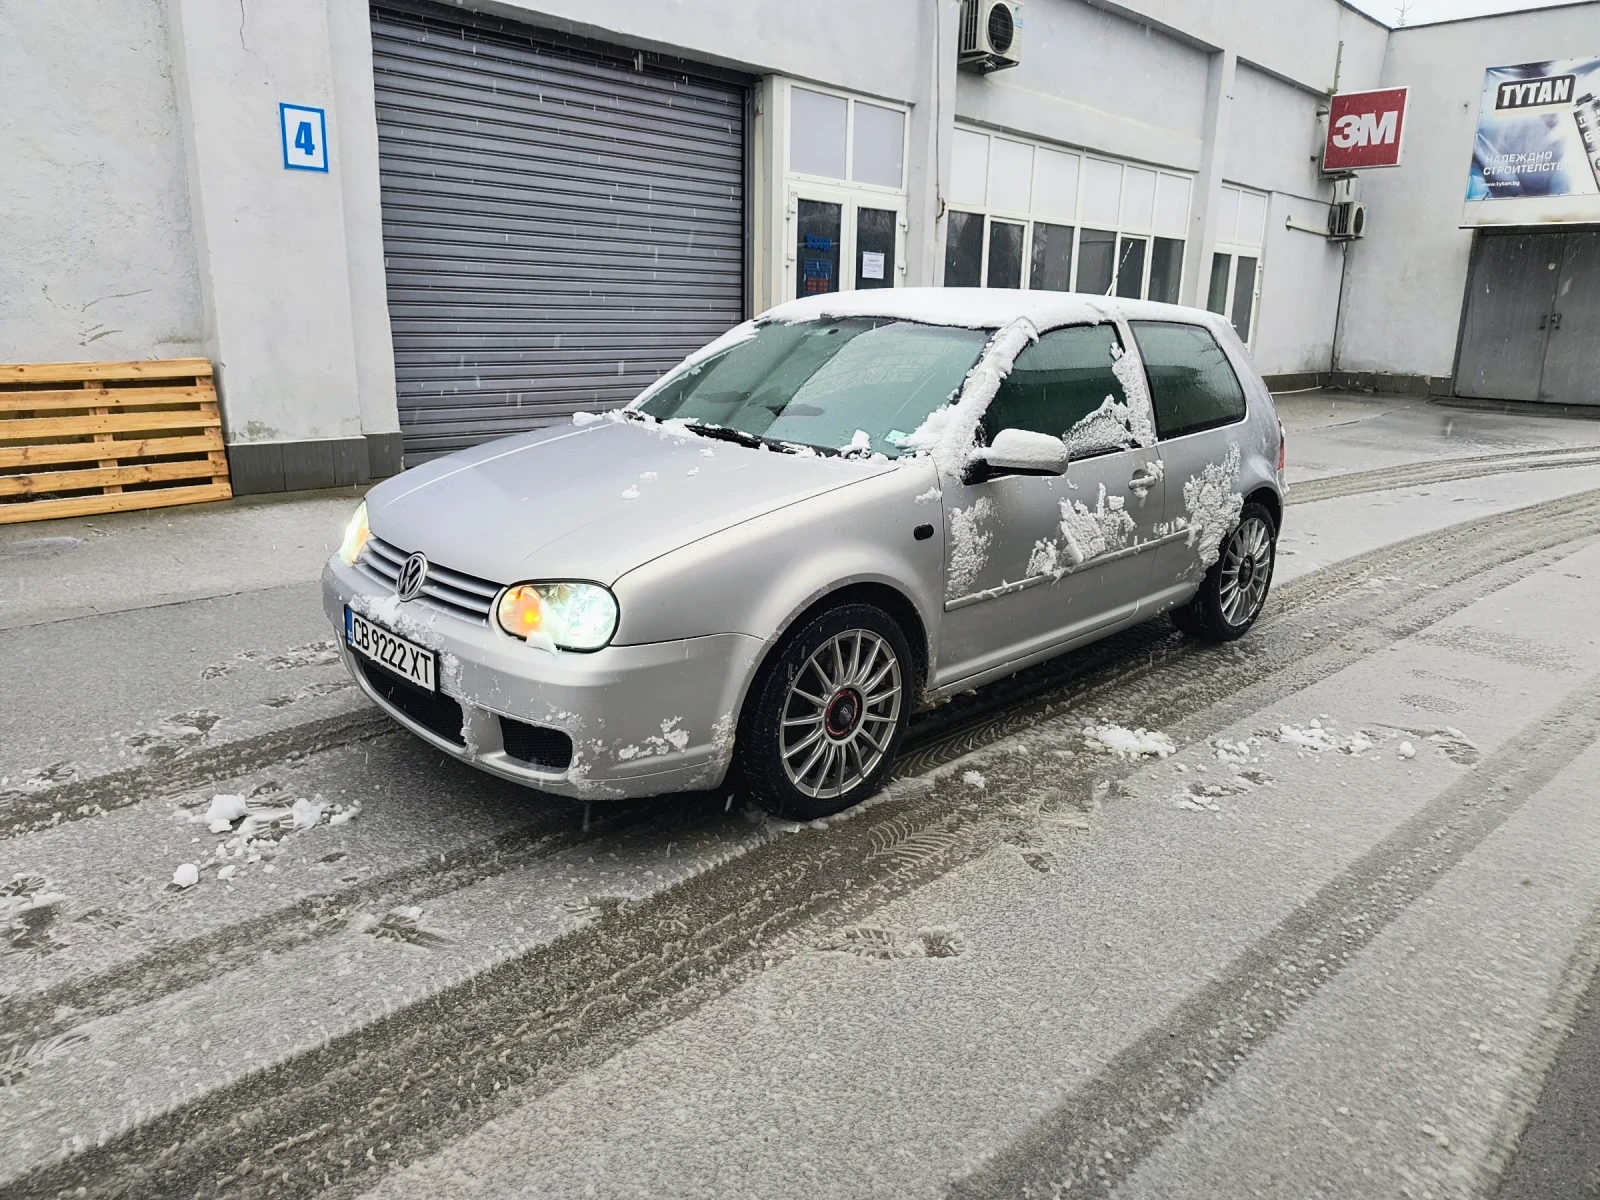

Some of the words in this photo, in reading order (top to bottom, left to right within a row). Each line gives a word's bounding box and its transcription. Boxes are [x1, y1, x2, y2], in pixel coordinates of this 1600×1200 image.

[1501, 78, 1571, 107] TYTAN
[295, 121, 315, 155] 4
[1332, 110, 1398, 148] 3M
[1485, 151, 1553, 164] НАДЕЖДНО
[1482, 180, 1520, 188] www.tytan.bg
[353, 617, 370, 651] CB
[371, 628, 407, 673] 9222
[410, 647, 431, 684] XT
